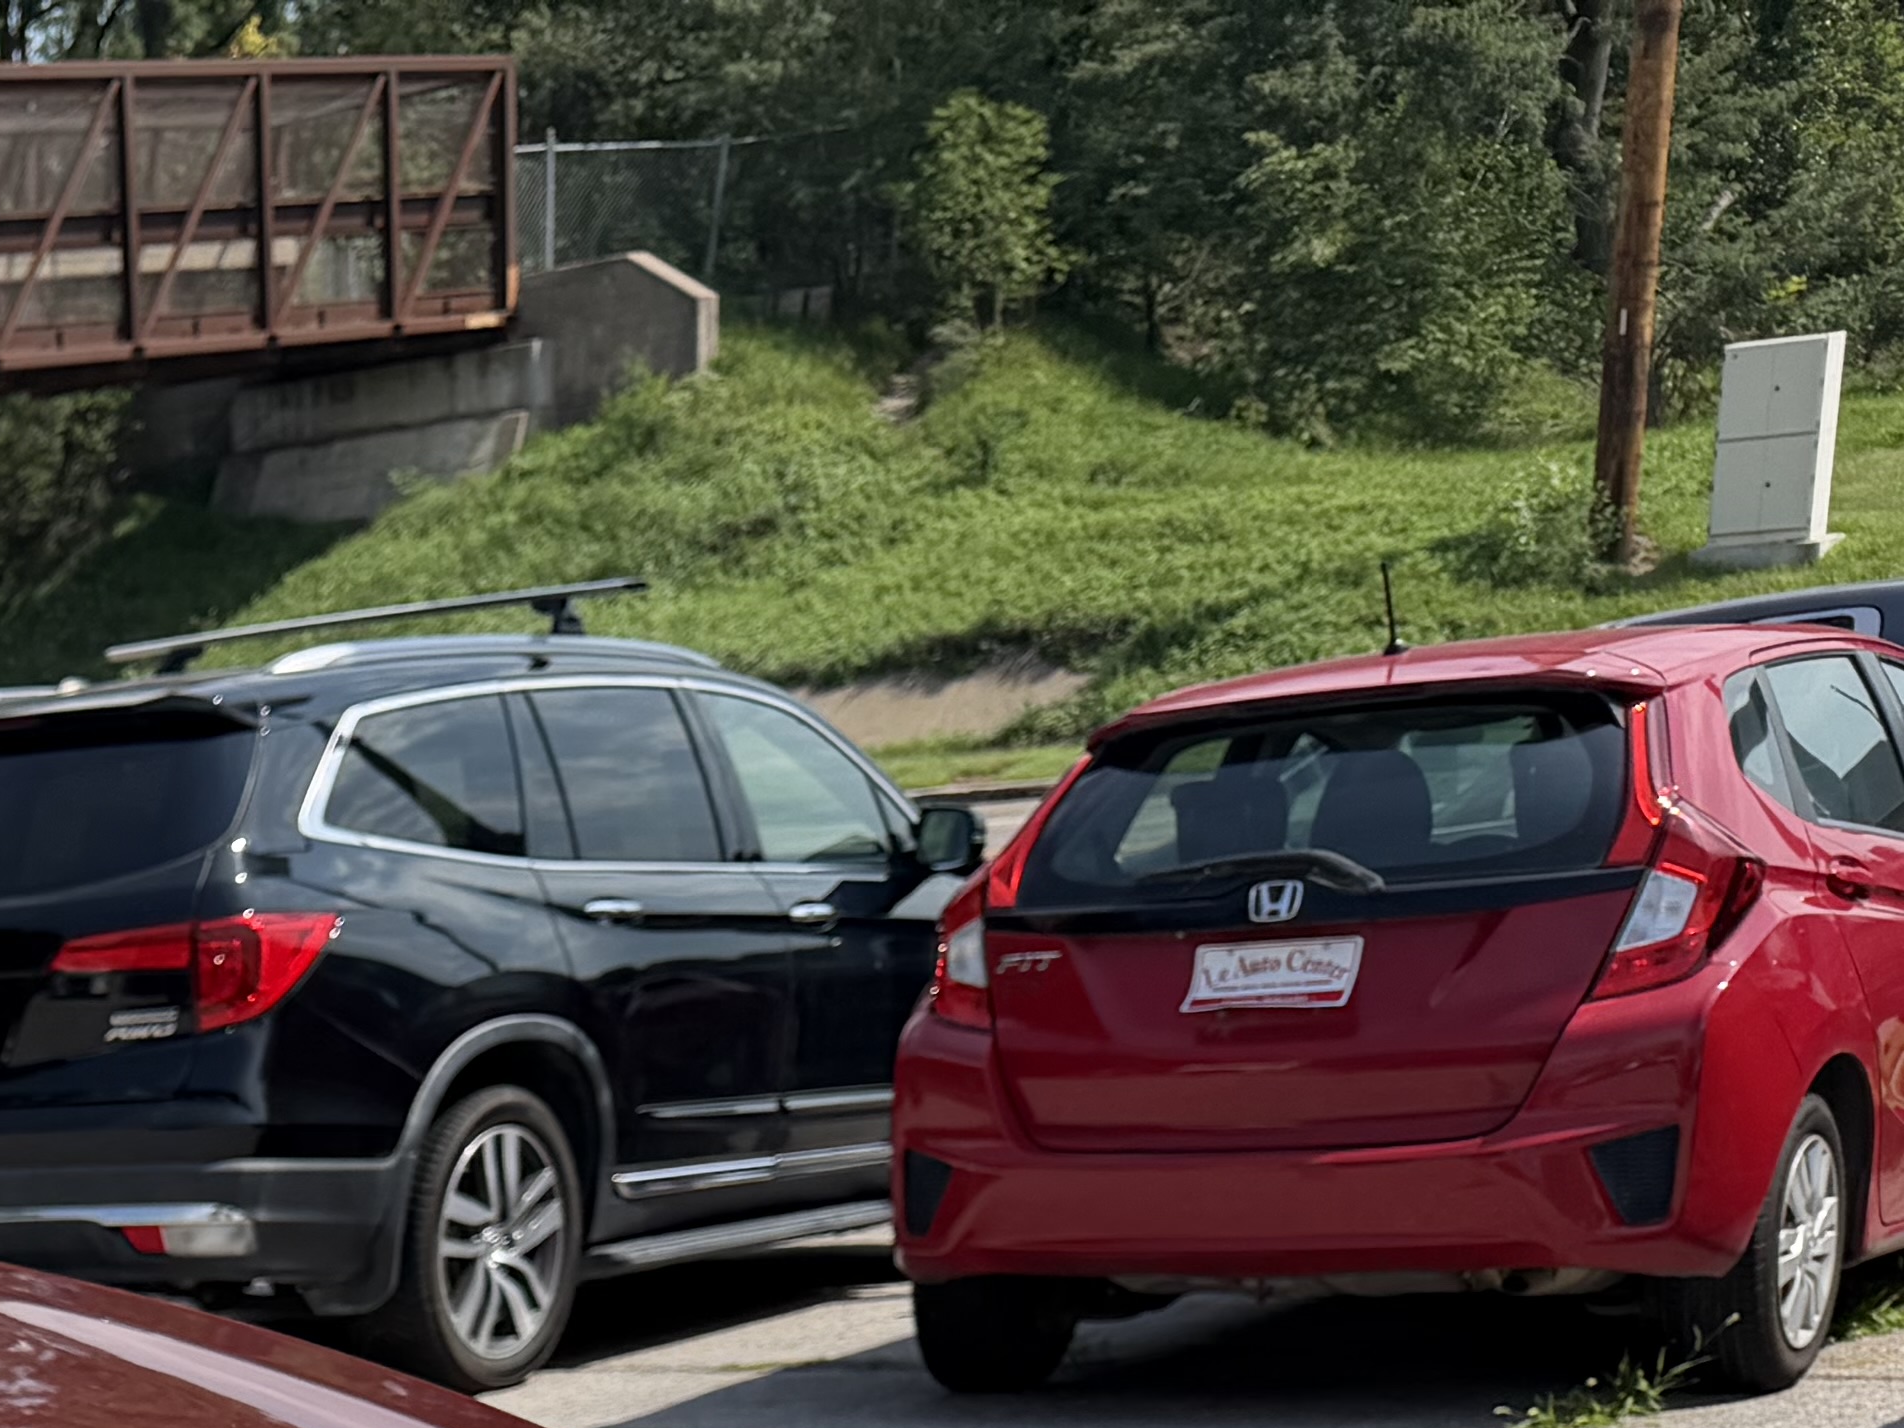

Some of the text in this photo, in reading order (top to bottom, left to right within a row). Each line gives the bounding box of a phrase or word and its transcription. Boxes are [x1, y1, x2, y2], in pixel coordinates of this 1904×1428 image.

[995, 950, 1063, 975] FIT
[1234, 955, 1282, 978] Auto
[1286, 949, 1348, 980] Center
